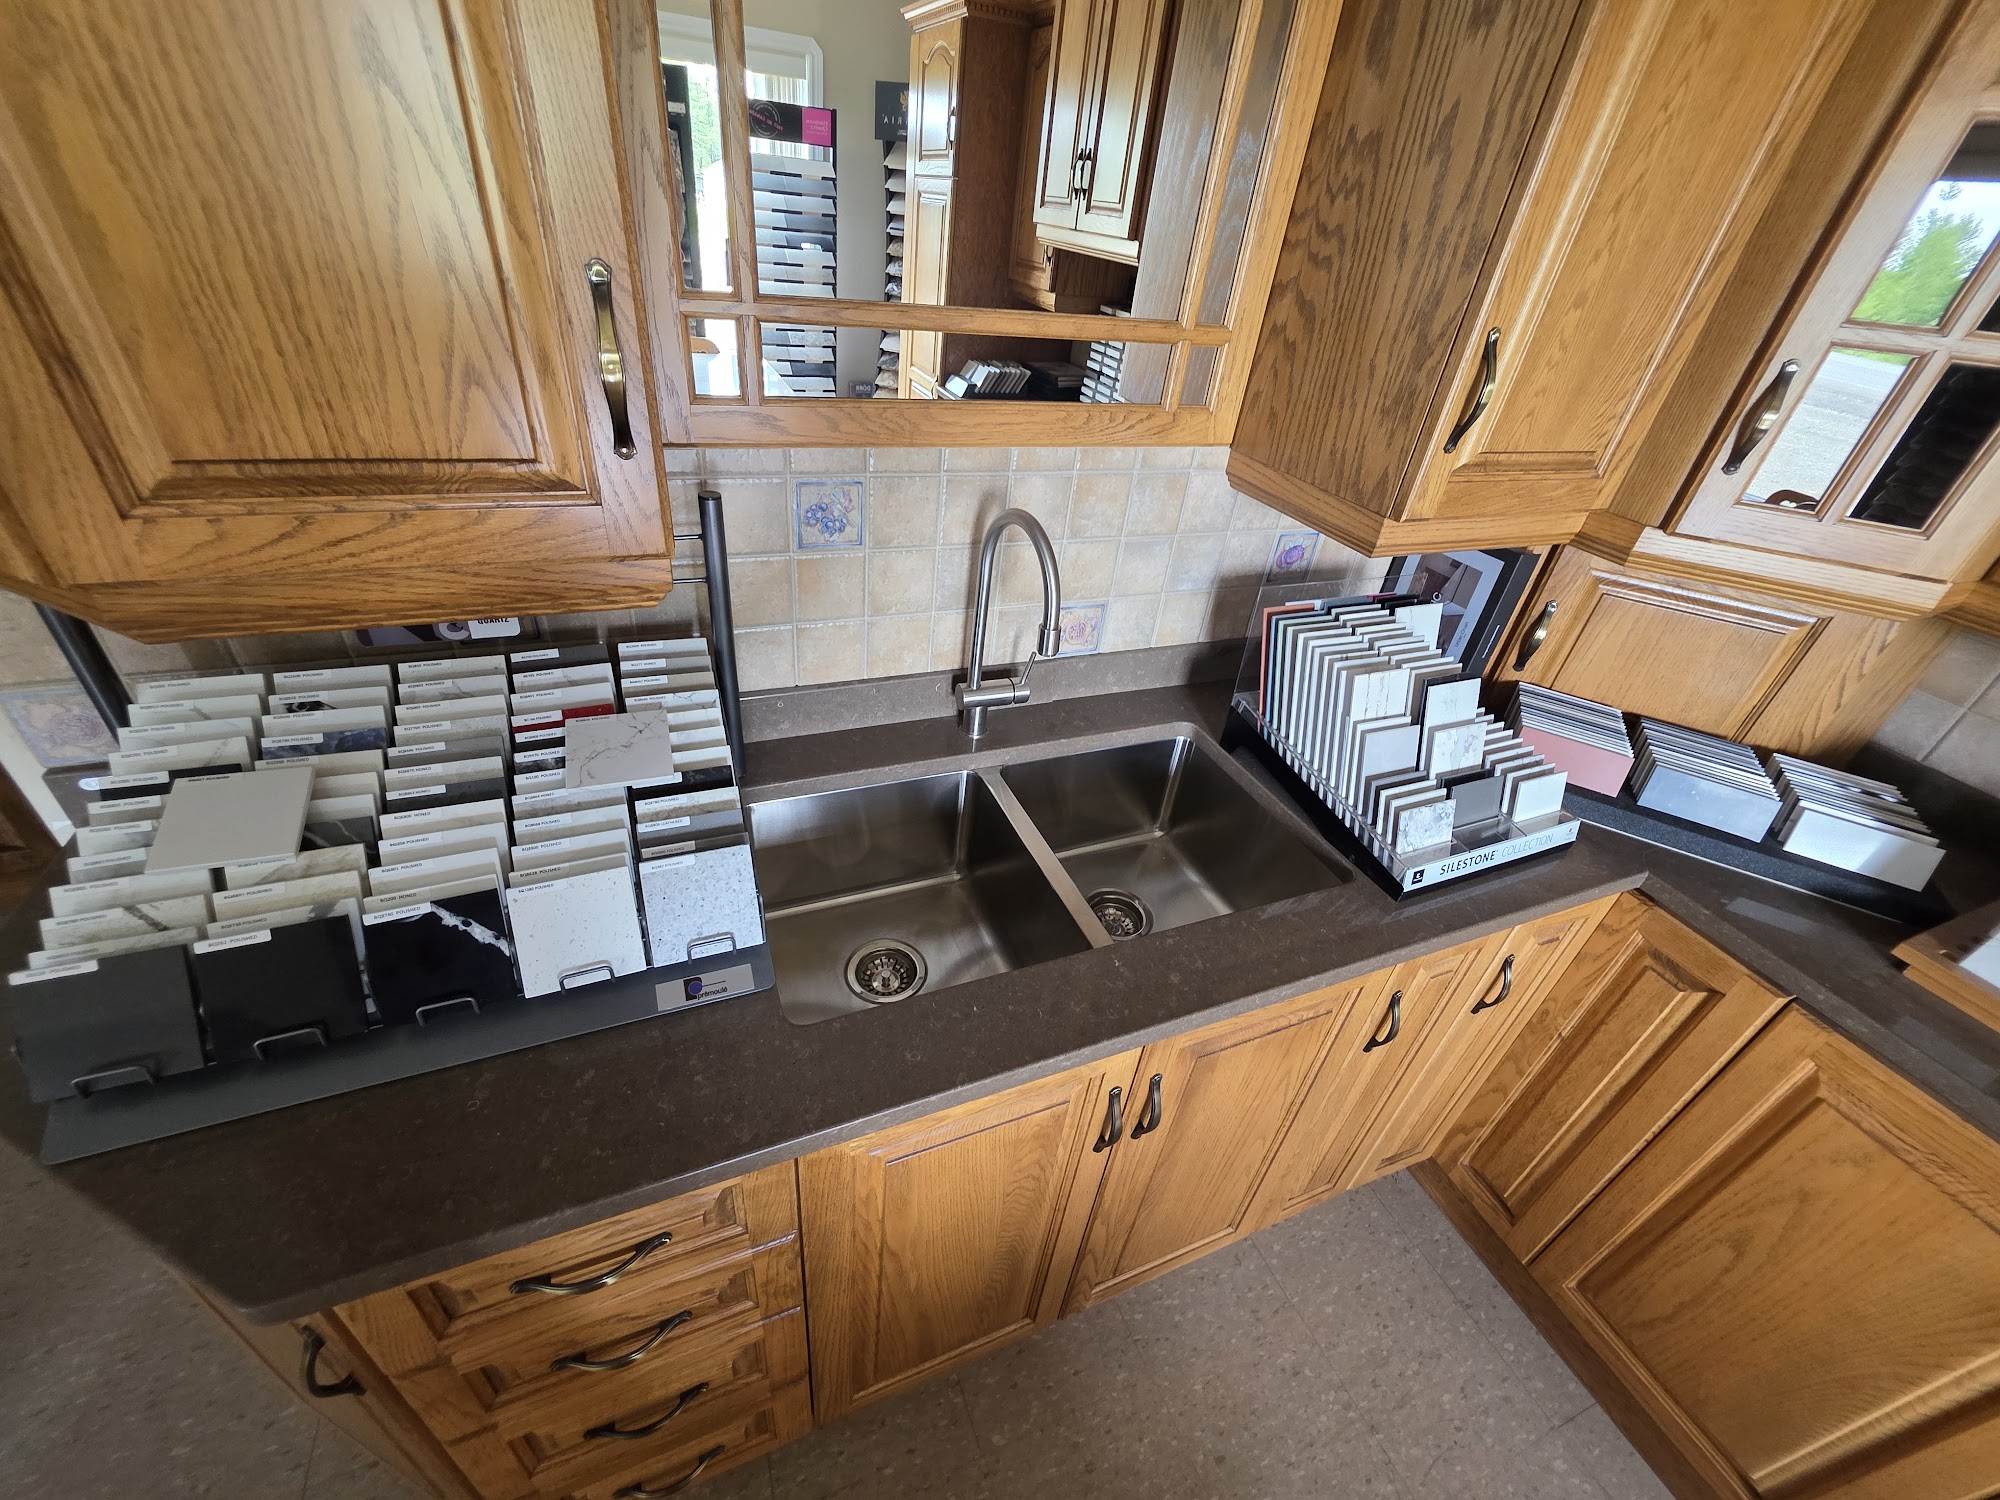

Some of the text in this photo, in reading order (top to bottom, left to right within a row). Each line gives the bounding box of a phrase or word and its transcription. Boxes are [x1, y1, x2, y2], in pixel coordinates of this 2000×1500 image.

[1440, 833, 1554, 876] SILESTONE COLLECTION
[396, 906, 421, 915] POLISHED
[242, 917, 267, 925] POLISHED
[230, 934, 257, 943] POLISHED
